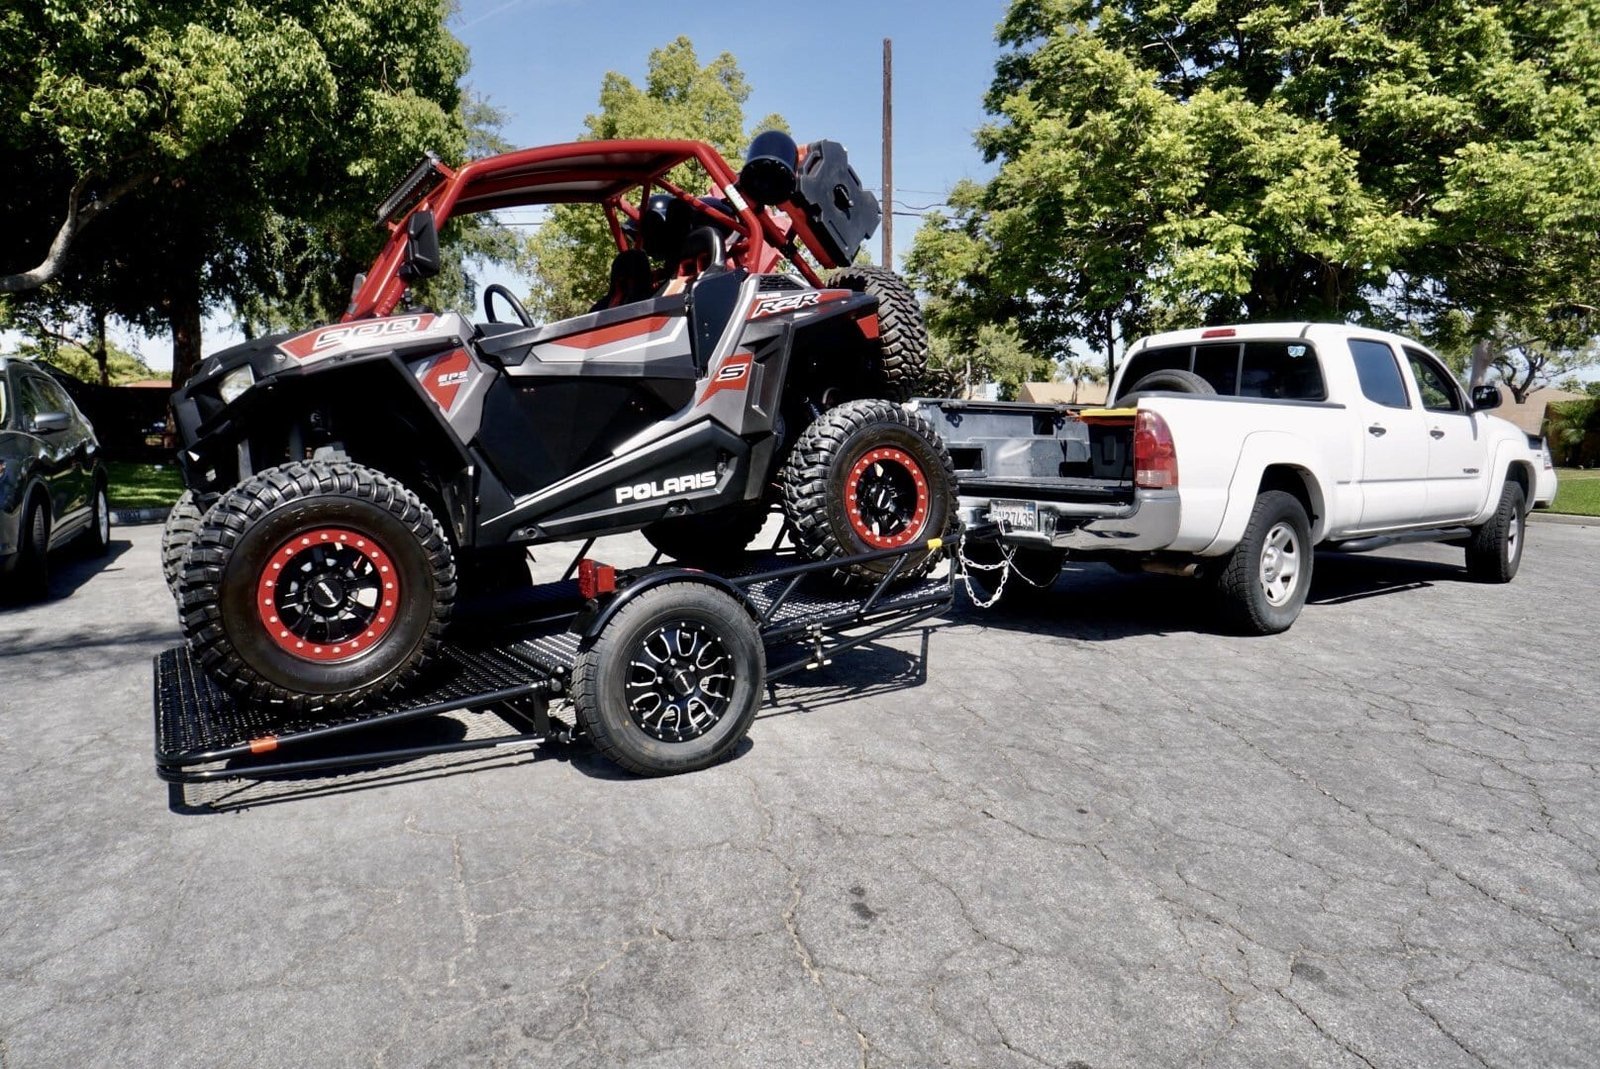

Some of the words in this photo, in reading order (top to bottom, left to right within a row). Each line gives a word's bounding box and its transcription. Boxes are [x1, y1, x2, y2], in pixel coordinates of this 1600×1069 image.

[750, 292, 820, 319] RZR
[715, 363, 749, 382] S
[615, 470, 717, 504] POLARIS
